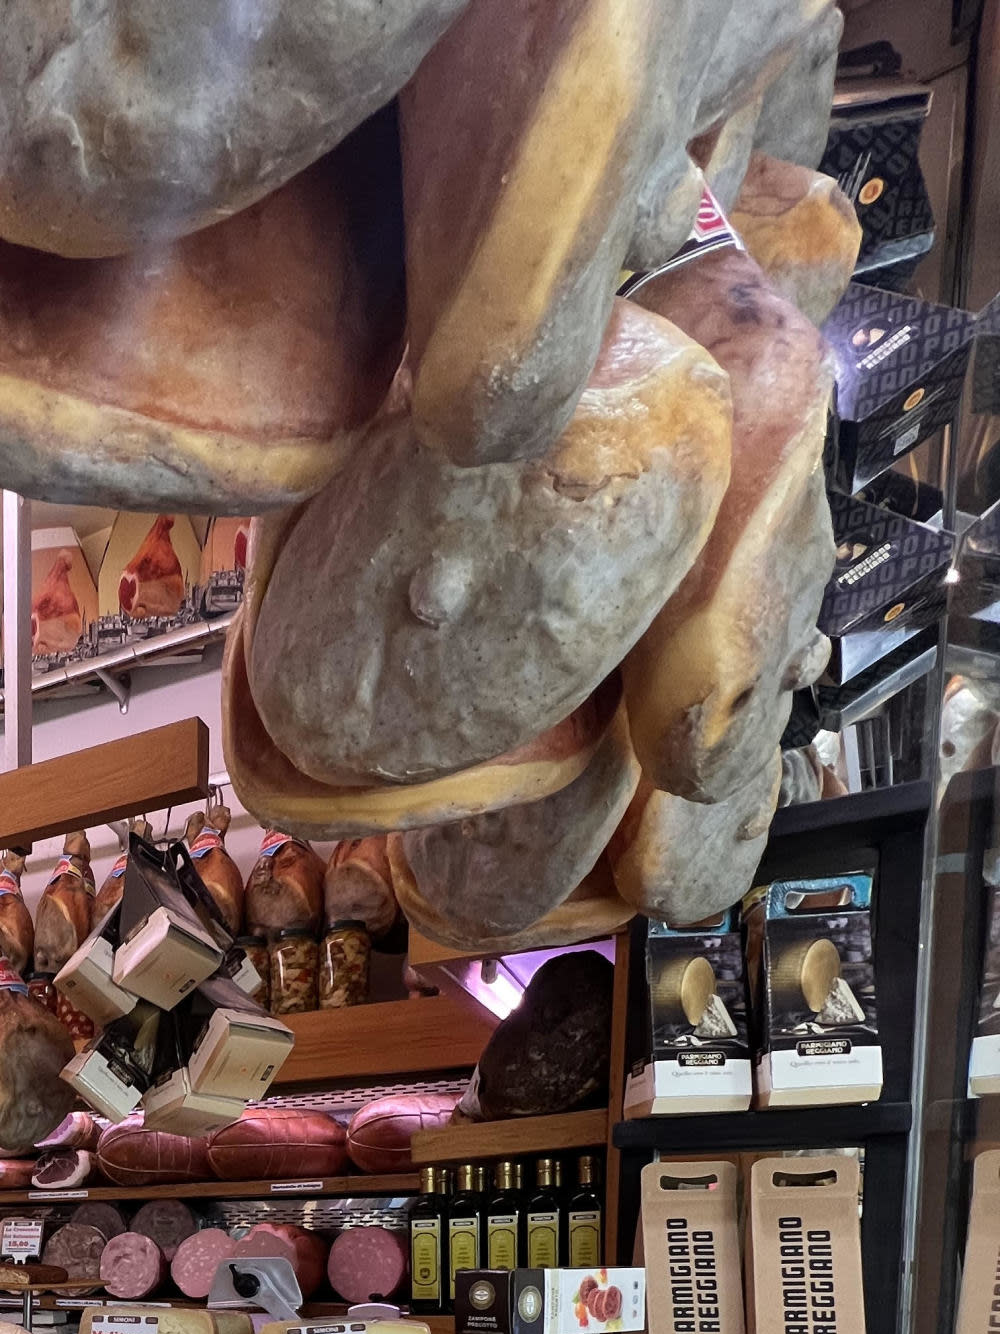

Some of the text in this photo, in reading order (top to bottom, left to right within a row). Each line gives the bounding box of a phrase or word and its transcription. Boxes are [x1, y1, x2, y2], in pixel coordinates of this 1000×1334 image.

[801, 1041, 847, 1049] PARMIGIANO
[805, 1047, 843, 1055] REGGIANO
[692, 1231, 720, 1332] REGGIANO
[468, 1315, 497, 1323] ZAMPONE
